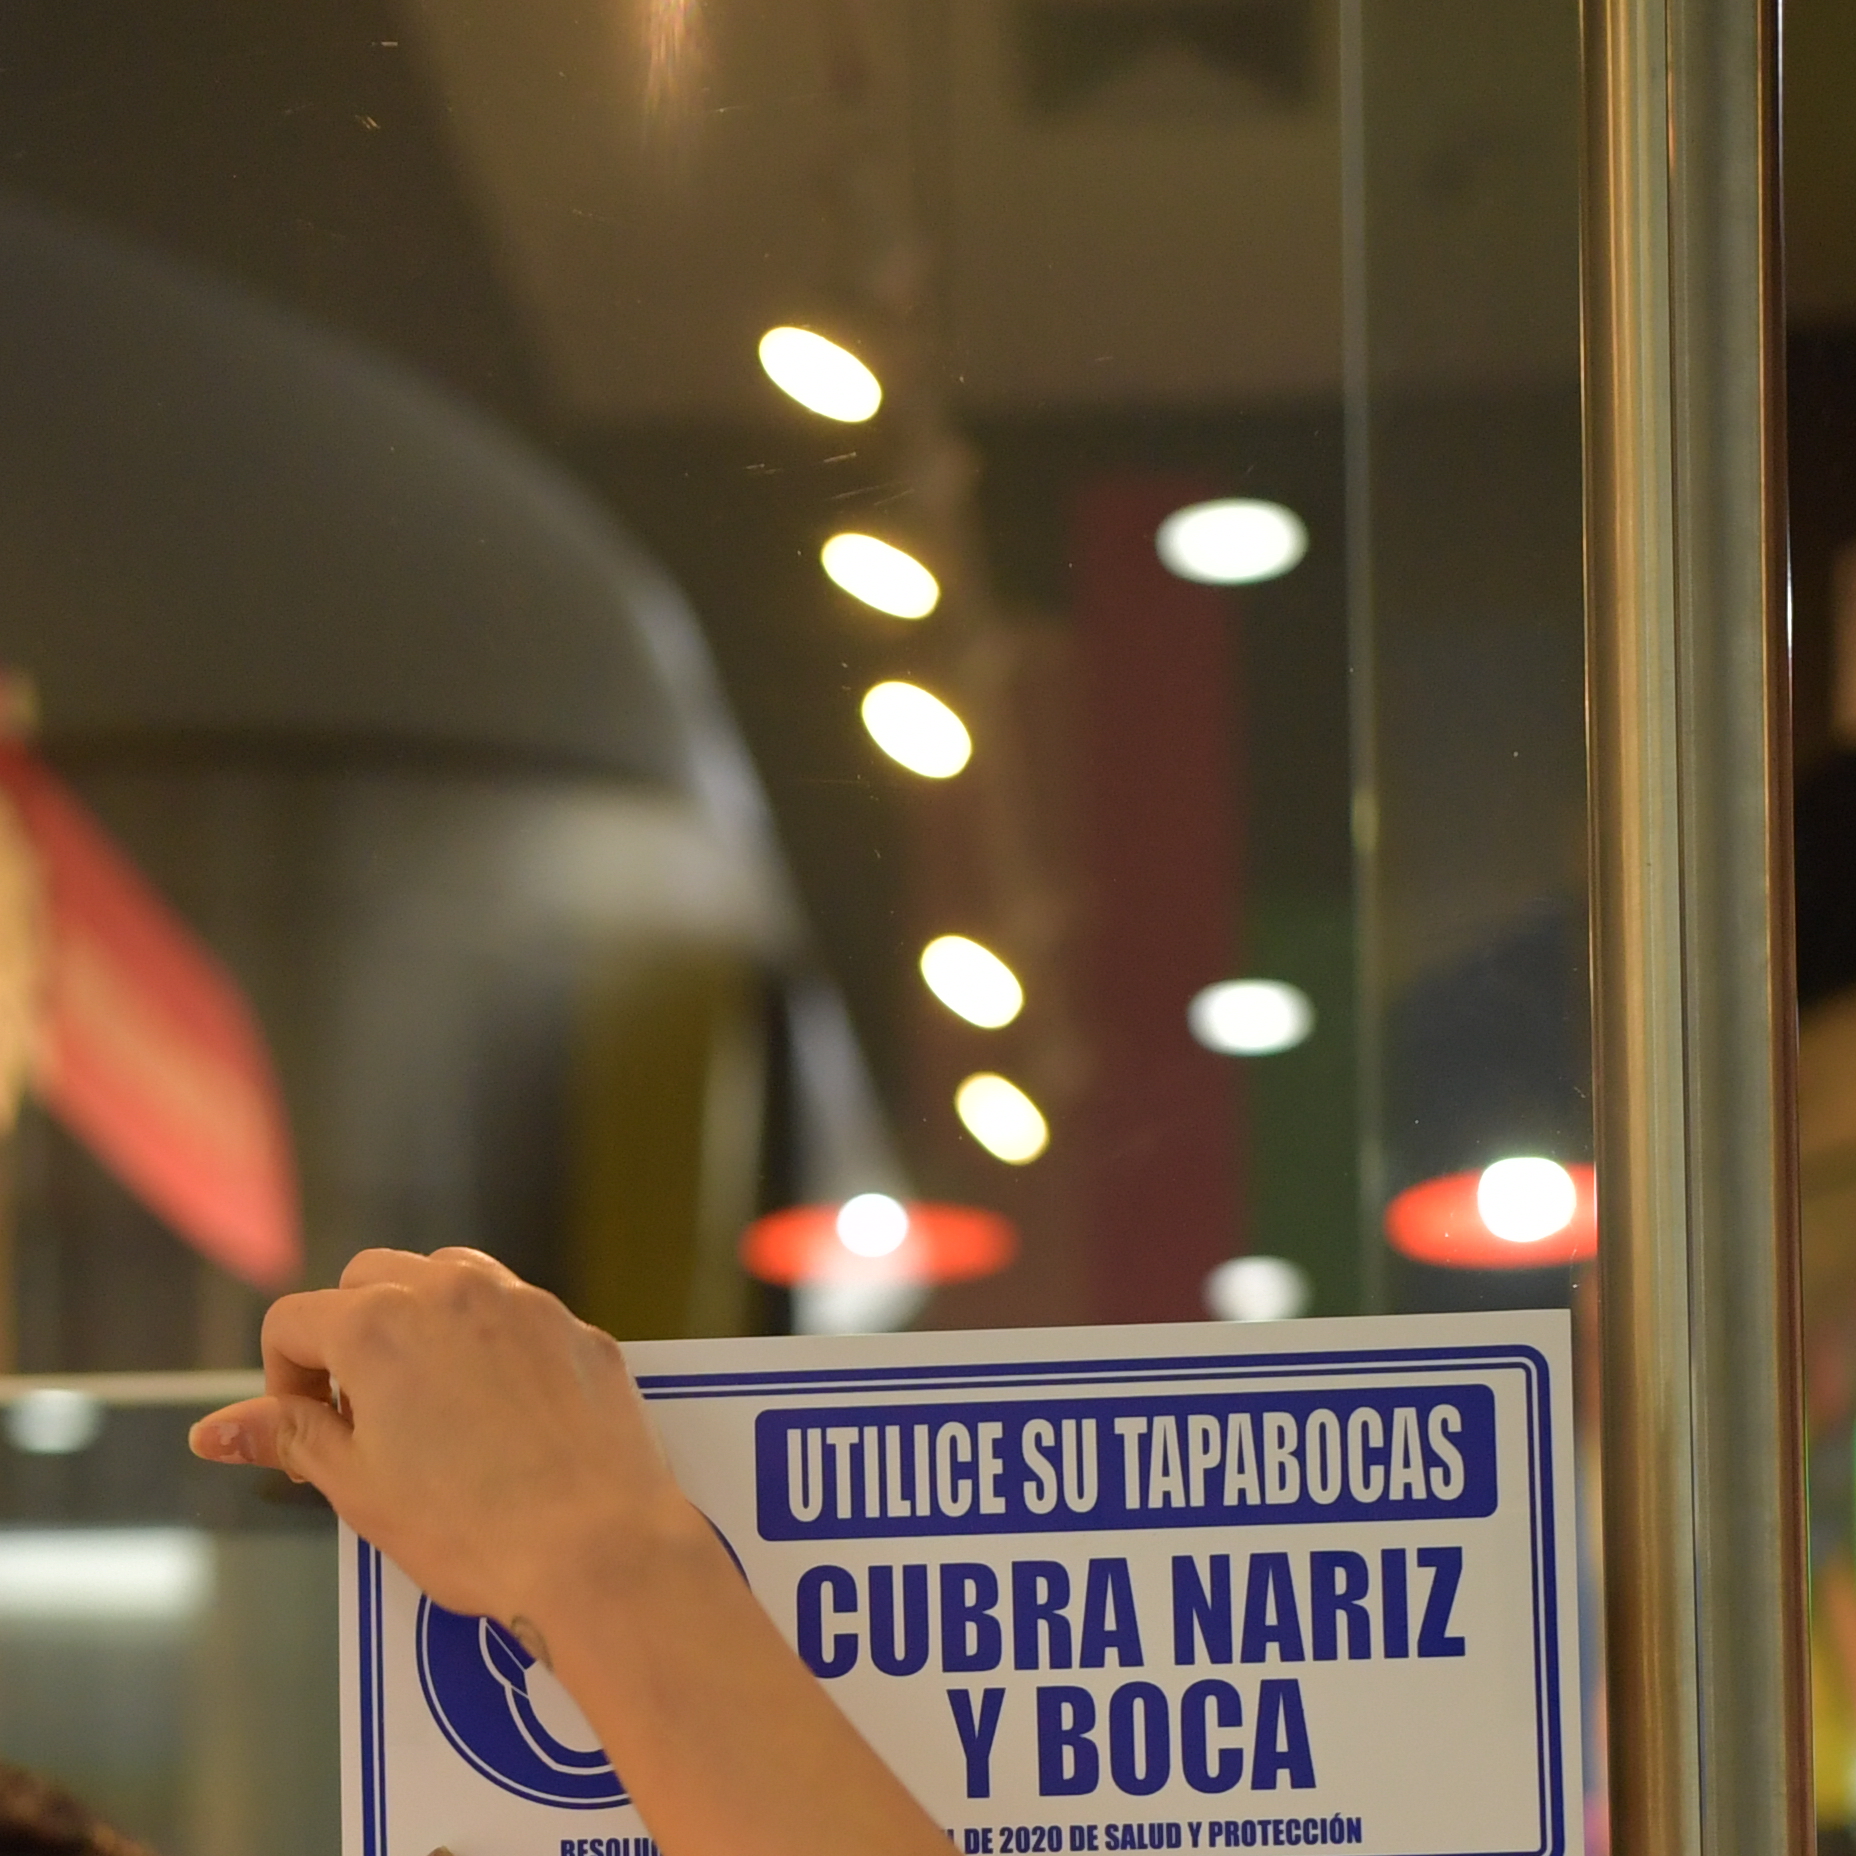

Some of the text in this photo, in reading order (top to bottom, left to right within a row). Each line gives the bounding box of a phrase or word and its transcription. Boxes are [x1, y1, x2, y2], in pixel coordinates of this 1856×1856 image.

[786, 1404, 1466, 1523] UTILICE SU TAPABOCAS
[795, 1545, 1467, 1679] CUBRA NARIZ
[946, 1677, 1317, 1799] Y BOCA
[964, 1828, 994, 1854] DE
[999, 1825, 1063, 1854] 2020
[1069, 1824, 1099, 1852] DE
[1104, 1821, 1182, 1851] SALUD
[1188, 1820, 1203, 1848] Y
[1208, 1812, 1363, 1848] PROTECCIÓN
